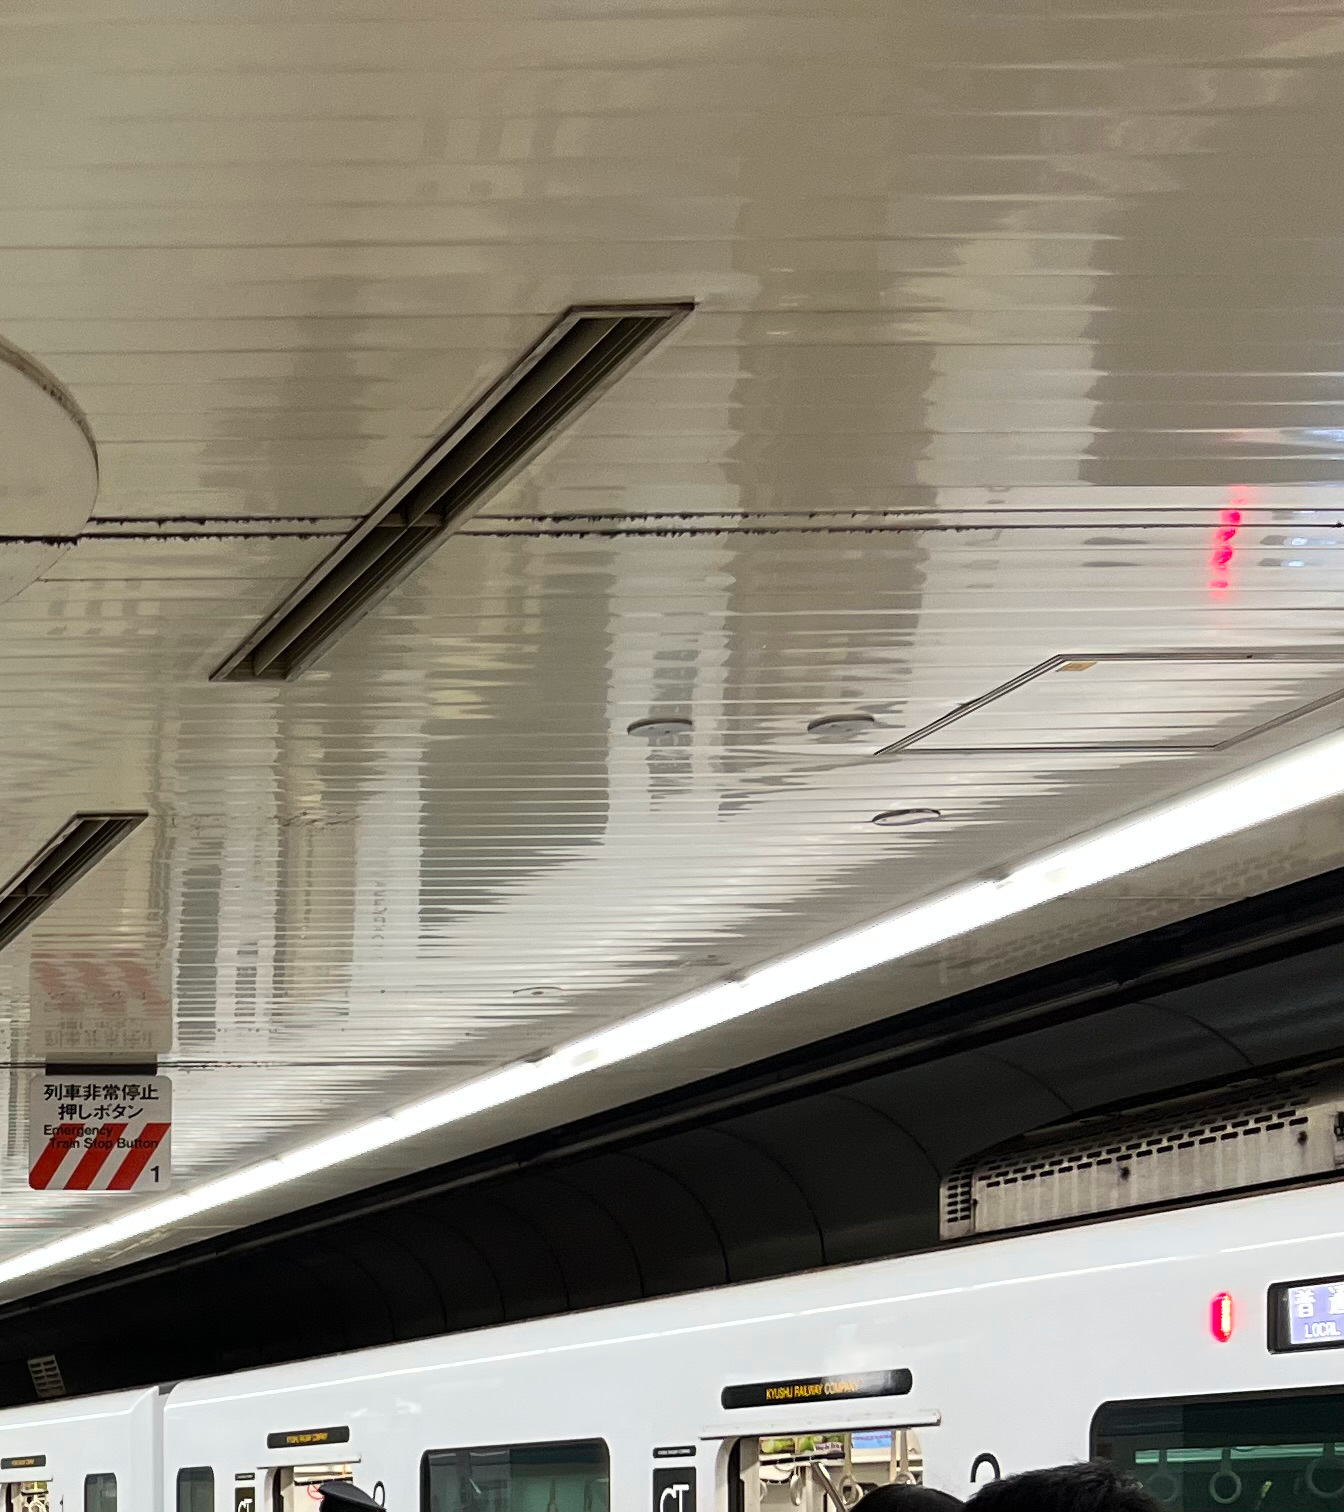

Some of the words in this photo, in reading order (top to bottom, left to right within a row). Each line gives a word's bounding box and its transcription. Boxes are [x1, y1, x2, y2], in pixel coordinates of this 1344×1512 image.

[44, 1083, 159, 1101] 列車非常停止
[58, 1103, 144, 1120] 押しボタン
[44, 1124, 112, 1137] Emergency
[49, 1137, 80, 1148] Train
[84, 1137, 111, 1150] Stop
[117, 1137, 158, 1149] Button
[150, 1165, 159, 1183] 1
[1304, 1320, 1342, 1339] LOCAL
[766, 1386, 793, 1400] KYUSHU
[794, 1384, 823, 1398] RAILWAY
